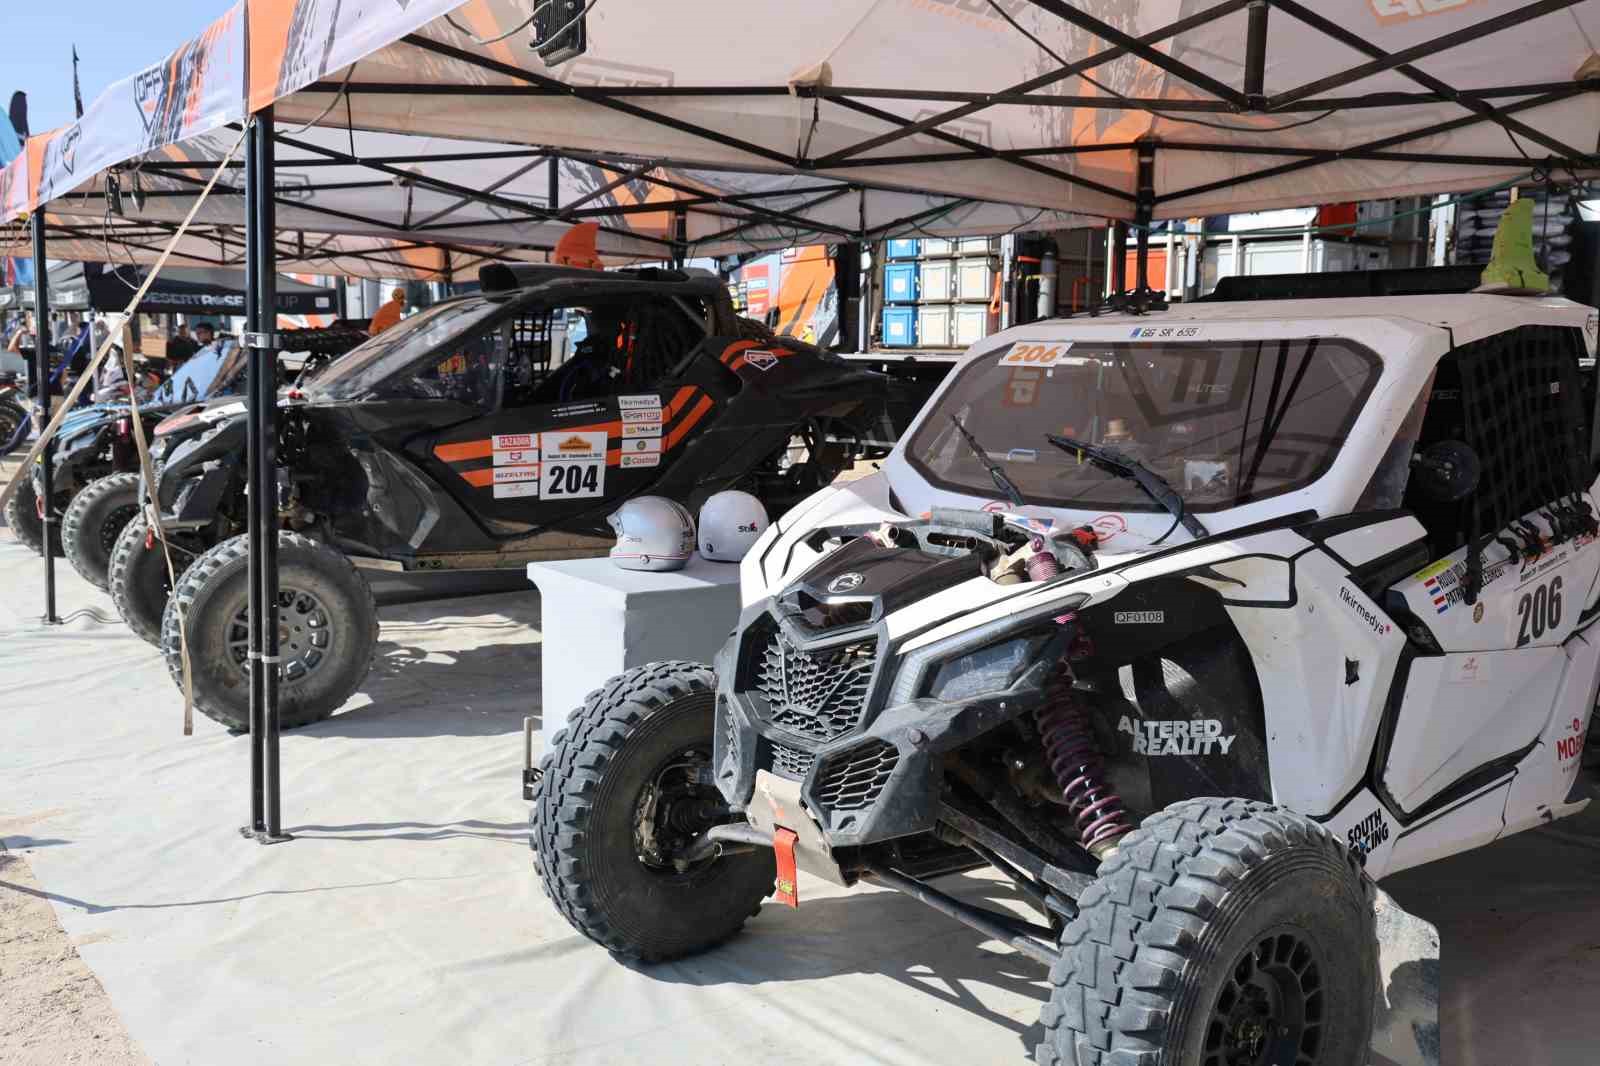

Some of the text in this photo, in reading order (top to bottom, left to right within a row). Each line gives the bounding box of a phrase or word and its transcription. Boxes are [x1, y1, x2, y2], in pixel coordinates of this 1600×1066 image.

[1176, 327, 1197, 337] 655
[1007, 344, 1058, 362] 206
[548, 464, 599, 495] 204
[1339, 586, 1385, 635] fikirmedya
[1516, 574, 1563, 648] 206
[1117, 715, 1223, 739] ALTERED
[1133, 735, 1237, 756] REALITY
[1347, 807, 1382, 849] SOUTH
